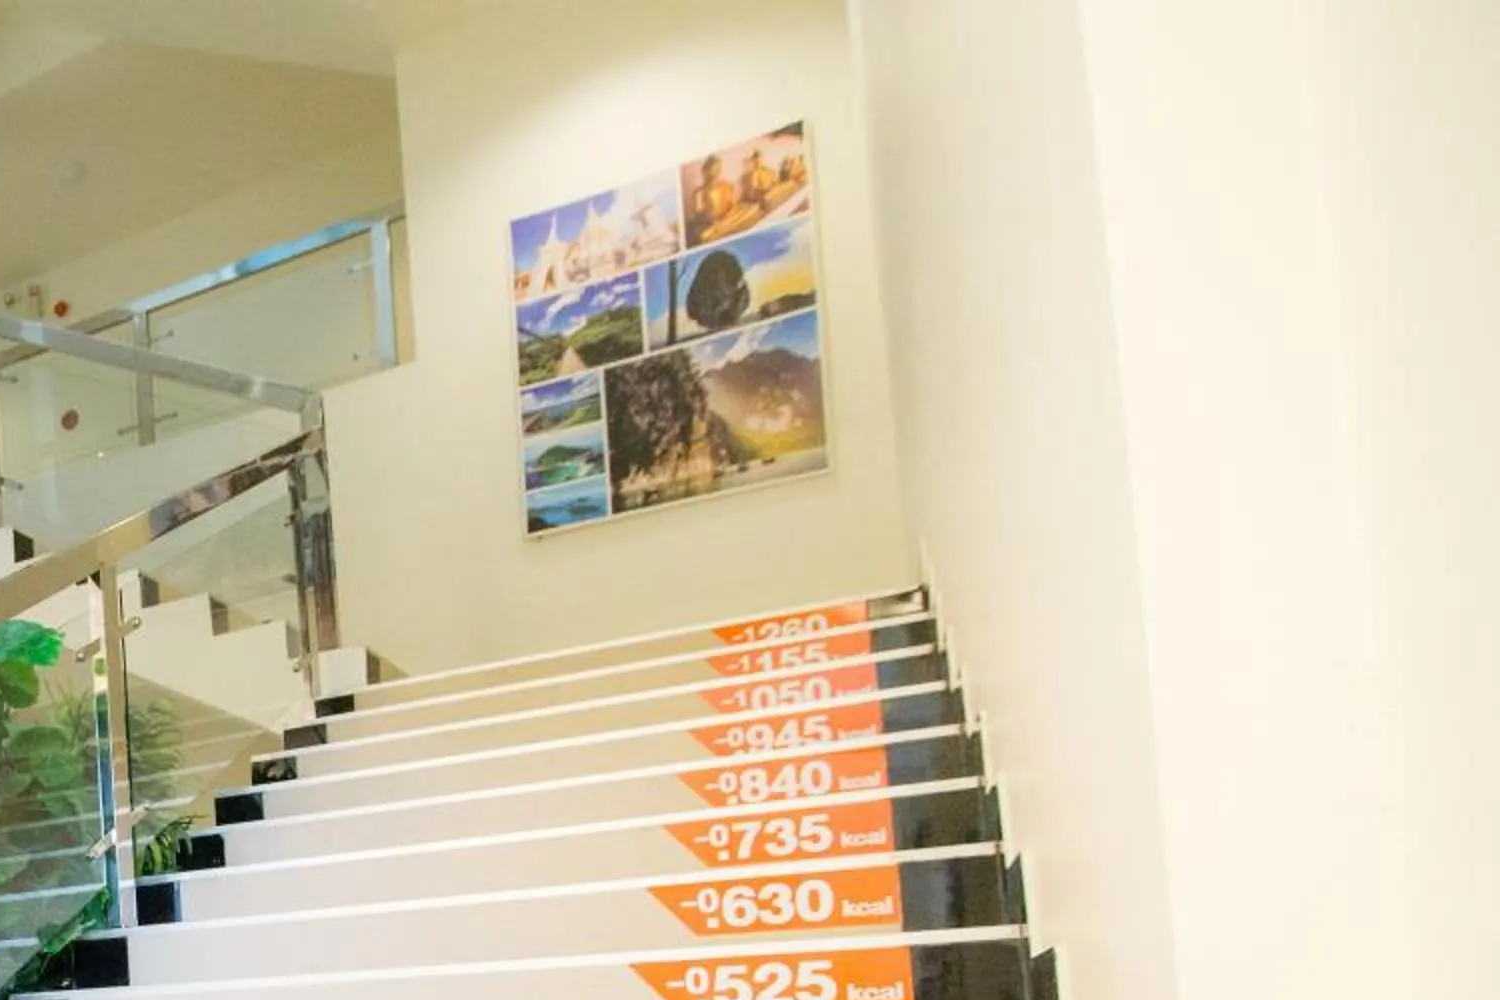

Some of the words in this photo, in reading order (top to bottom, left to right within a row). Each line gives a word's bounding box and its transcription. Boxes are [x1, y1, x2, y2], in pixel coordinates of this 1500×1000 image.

[838, 771, 882, 791] kcal
[839, 827, 887, 848] kcal
[841, 896, 894, 918] kcal
